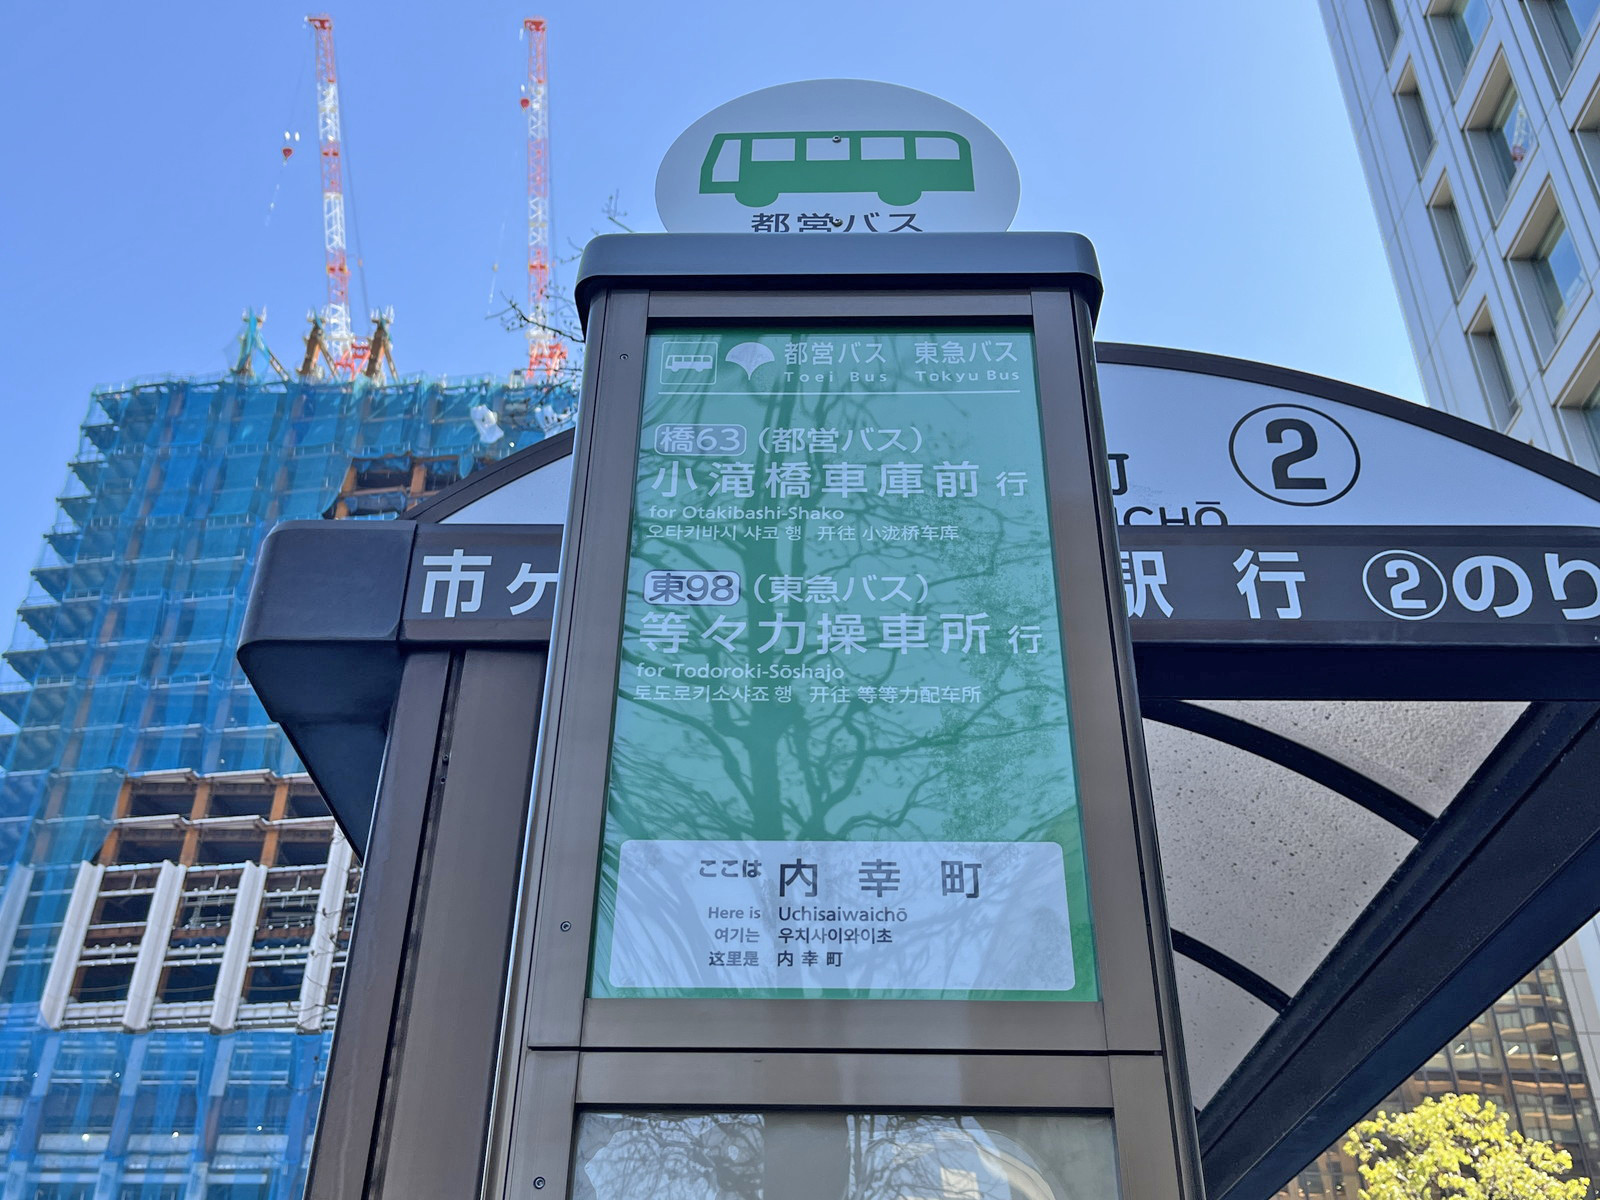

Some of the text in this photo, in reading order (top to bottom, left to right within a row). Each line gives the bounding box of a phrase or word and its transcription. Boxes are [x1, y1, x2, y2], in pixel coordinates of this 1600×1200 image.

[752, 212, 923, 232] 都営バス
[784, 340, 1018, 366] 都営バス 東急バス
[784, 369, 1020, 383] Toei Bus Tokyu Bus
[660, 428, 741, 454] 橋63
[649, 505, 845, 520] for Otakibashi-Shako
[646, 524, 802, 541] 오타키바시 샤코 행
[818, 525, 856, 541] 开往
[650, 573, 734, 603] 東98
[1233, 549, 1306, 620] 行
[636, 663, 845, 683] for Todoroki-Sōshajo
[633, 685, 792, 703] 토도로키소샤죠 행
[809, 685, 981, 703] 开往 等等力配车所
[699, 859, 762, 878] ここは
[708, 906, 908, 922] Here is Uchisaiwaichō
[714, 927, 893, 945] 여기는 우치사이와이초
[708, 951, 760, 967] 这里是
